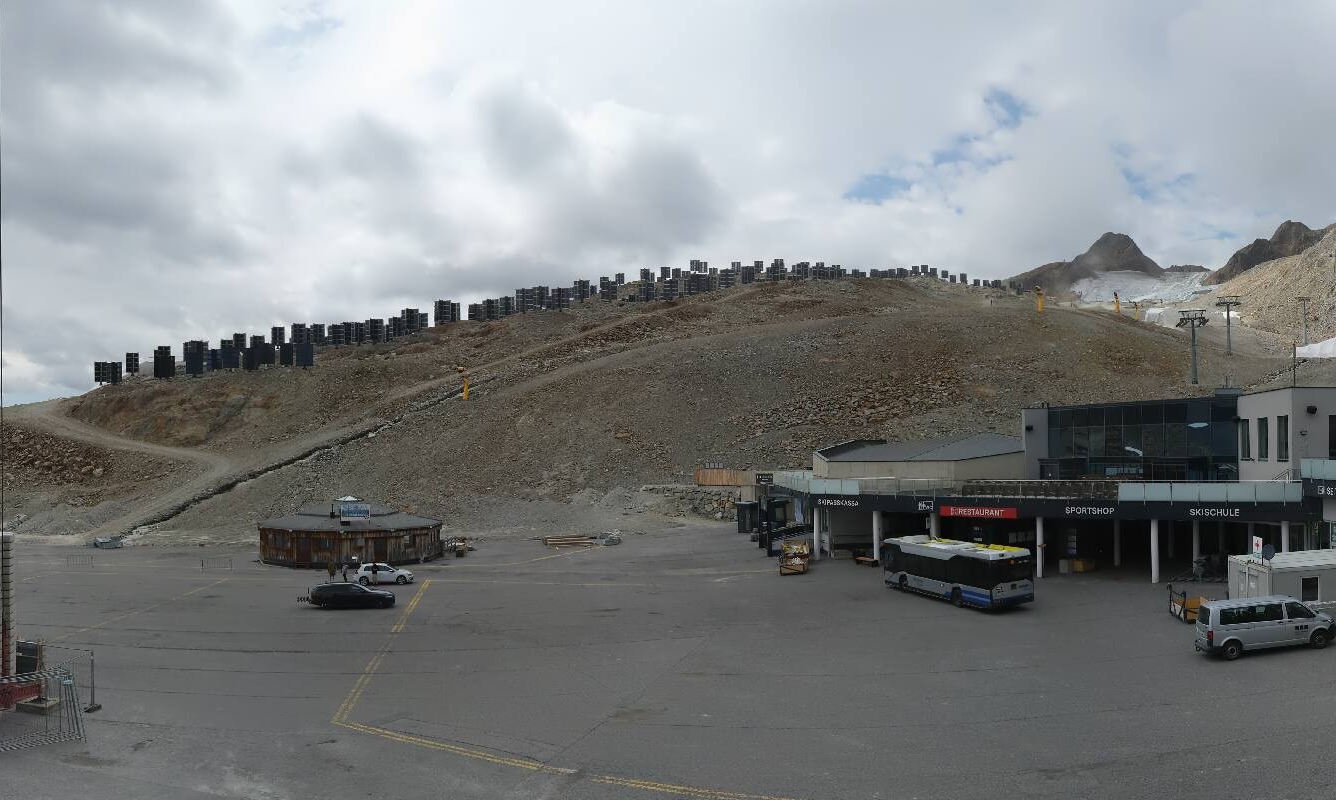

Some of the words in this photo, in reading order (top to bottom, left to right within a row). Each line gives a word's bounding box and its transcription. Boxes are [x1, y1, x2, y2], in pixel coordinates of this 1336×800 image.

[958, 508, 1005, 518] RESTAURANT
[1065, 506, 1115, 516] SPORTSHOP
[1189, 508, 1240, 517] SKISCHULE
